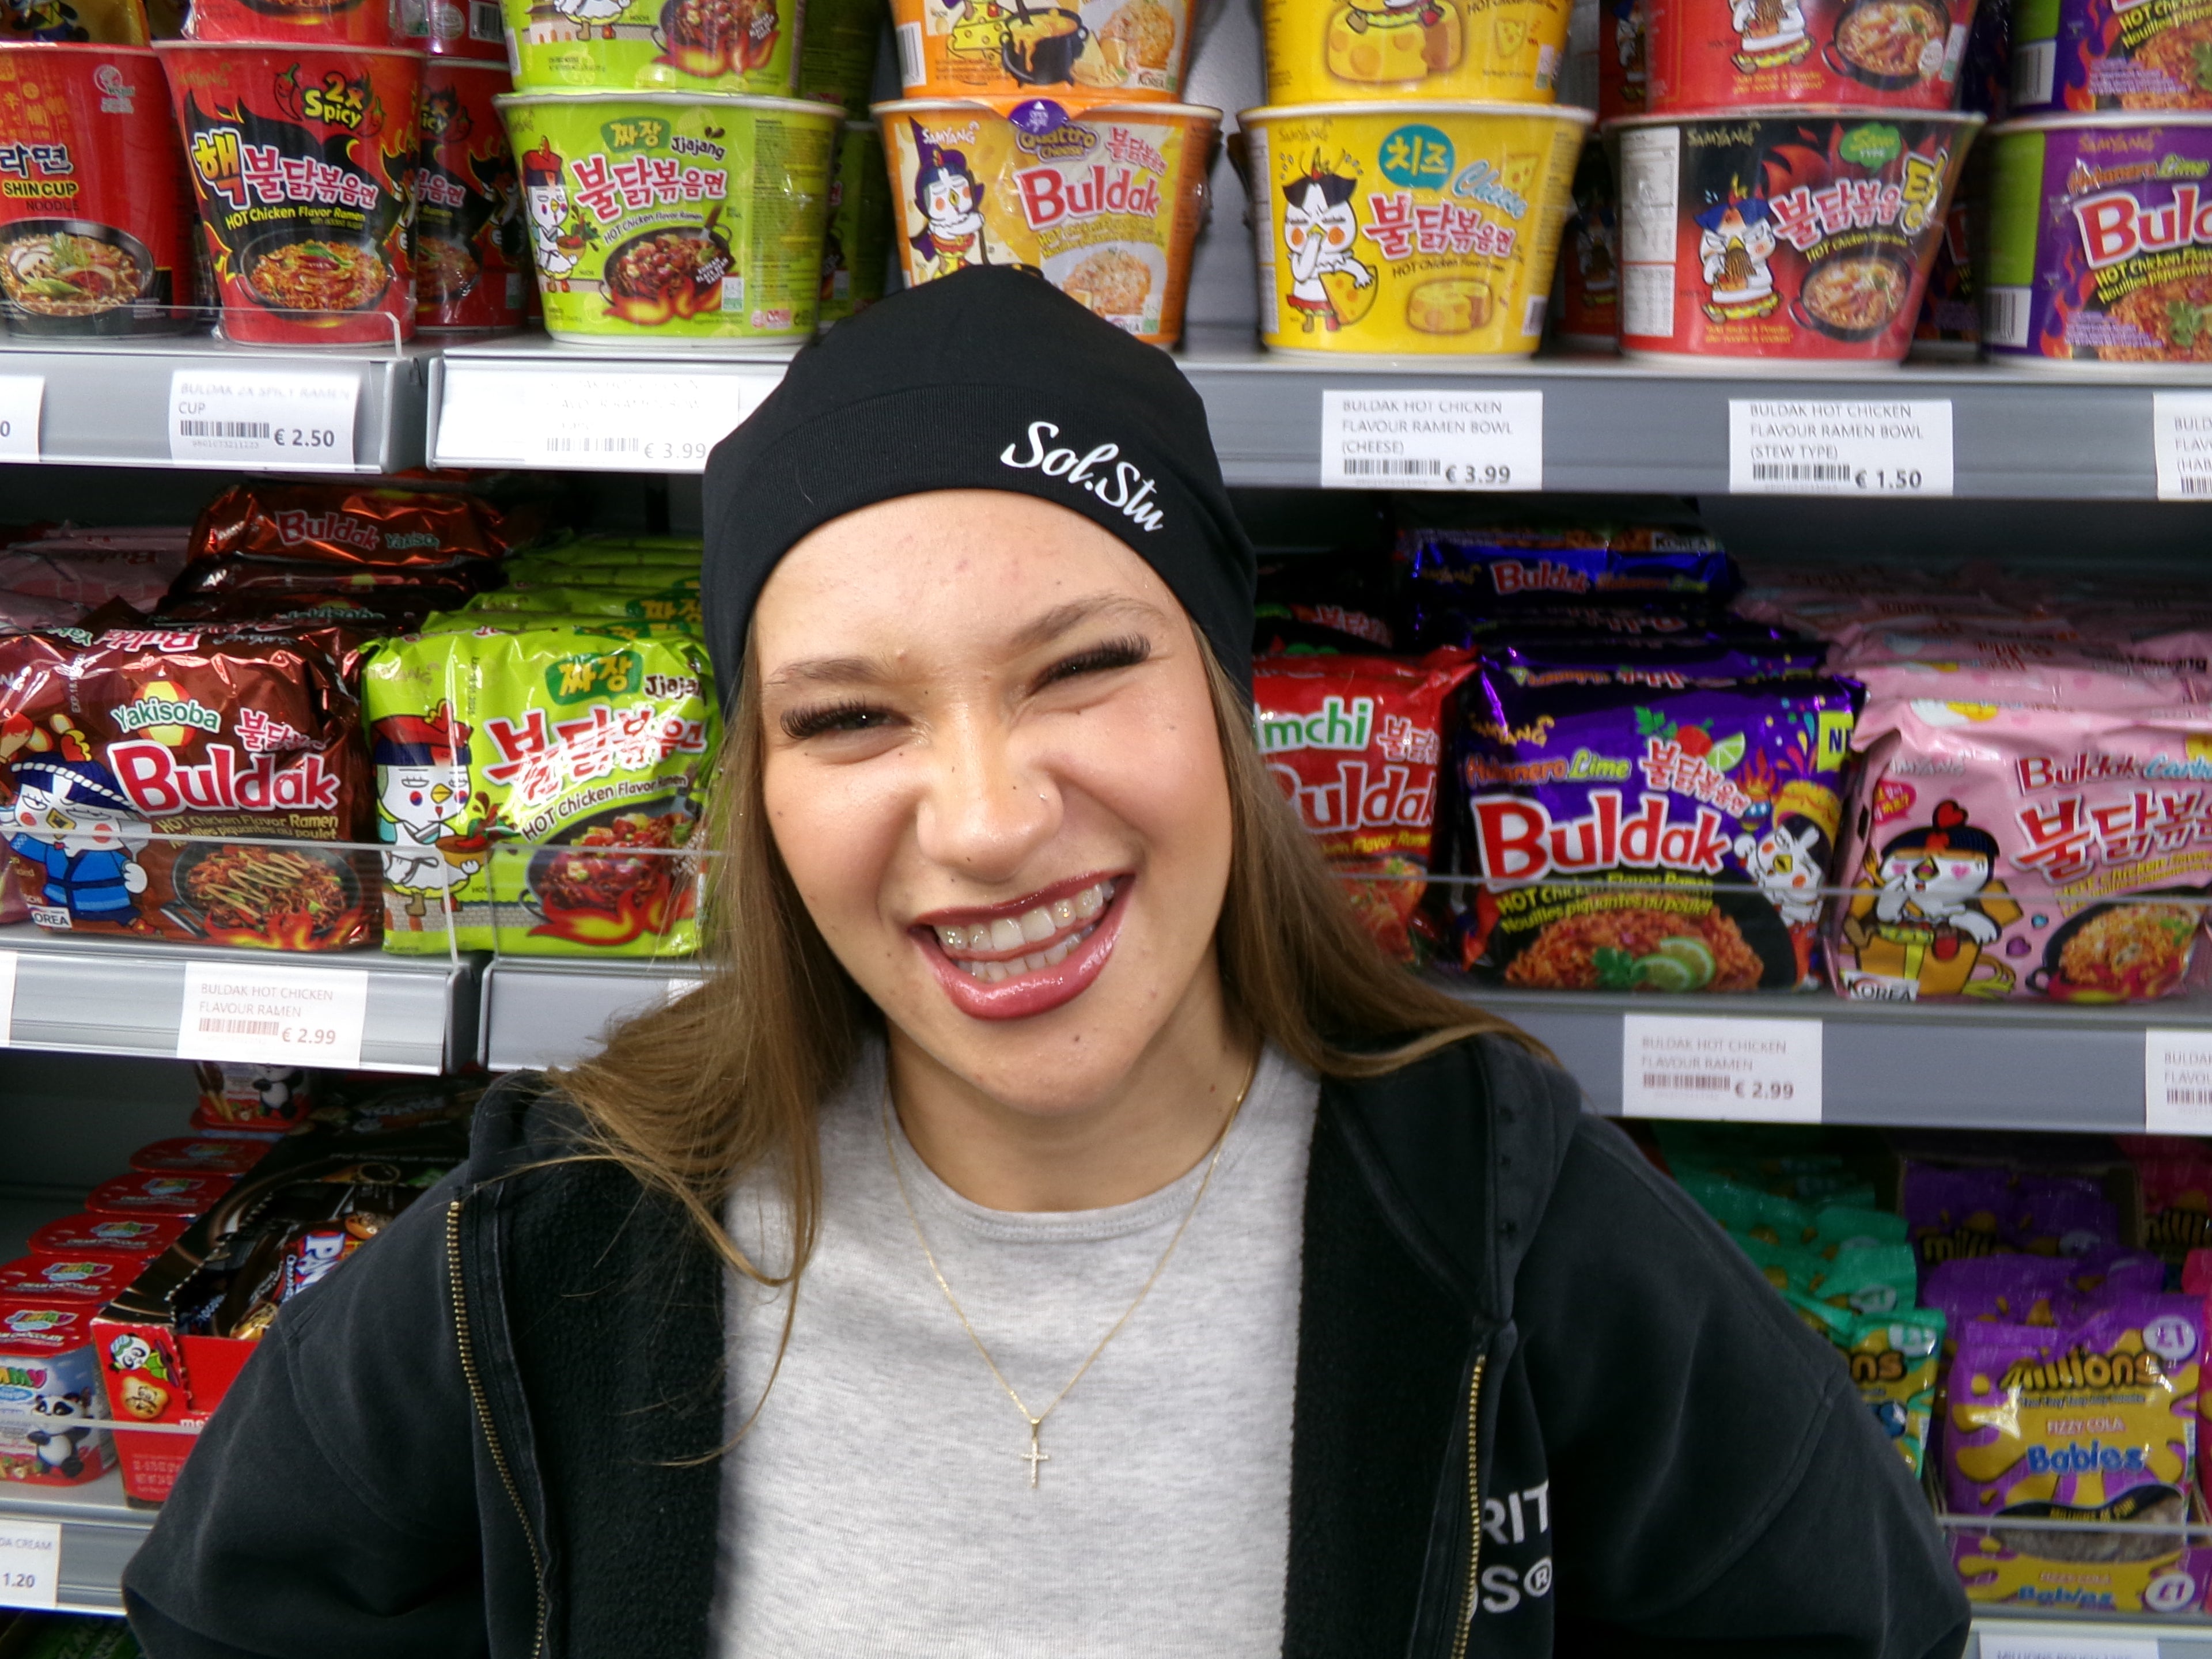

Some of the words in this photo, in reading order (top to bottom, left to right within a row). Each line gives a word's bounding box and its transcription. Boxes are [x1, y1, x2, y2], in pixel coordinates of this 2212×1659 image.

[2118, 3, 2152, 32] HOT
[324, 71, 365, 112] 2x
[303, 89, 363, 130] Spicy
[611, 120, 662, 149] 짜장
[922, 127, 977, 146] SAMYANG
[671, 135, 726, 161] Jjajang
[1385, 135, 1448, 177] 치즈
[0, 142, 74, 179] 라면
[3, 181, 40, 196] SHIN
[41, 181, 78, 197] CUP
[570, 153, 728, 224] 불닭볶음면
[1012, 164, 1162, 232] Buldak
[26, 200, 79, 211] NOODLE
[225, 210, 249, 230] HOT
[249, 206, 296, 222] Chicken
[298, 206, 332, 218] Flavor
[334, 207, 366, 222] Ramen
[1362, 191, 1517, 260] 불닭볶음면
[604, 228, 622, 245] HOT
[622, 213, 654, 230] Chicken
[1806, 245, 1830, 263] HOT
[1392, 266, 1418, 279] HOT
[1419, 258, 1459, 272] Chicken
[2094, 260, 2128, 287] HOT
[179, 401, 206, 414] CUP
[1343, 400, 1400, 413] BULDAK
[1404, 400, 1433, 413] HOT
[1440, 400, 1503, 414] CHICKEN
[1750, 403, 1808, 417] BULDAK
[1812, 403, 1842, 418] HOT
[1847, 403, 1912, 419] CHICKEN
[1342, 419, 1408, 434] FLAVOUR
[1412, 420, 1466, 434] RAMEN
[1471, 421, 1514, 435] BOWL
[1750, 423, 1817, 438] FLAVOUR
[1821, 423, 1876, 439] RAMEN
[1880, 425, 1924, 440] BOWL
[274, 428, 286, 446] €
[292, 429, 335, 448] 2.50
[1342, 440, 1404, 456] (CHEESE)
[644, 443, 654, 459] €
[663, 443, 707, 459] 3.99
[1750, 444, 1795, 460] (STEW
[1799, 444, 1839, 460] TYPE)
[1445, 464, 1457, 483] €
[1465, 464, 1512, 484] 3.99
[1855, 468, 1868, 489] €
[1877, 468, 1922, 489] 1.50
[275, 509, 380, 551] Buldak
[1489, 558, 1592, 596] Buldak
[559, 656, 632, 696] 짜장
[110, 698, 221, 734] Yakisoba
[1255, 695, 1374, 752] mchi
[1567, 747, 1631, 782] Lime
[107, 740, 341, 816] Buldak
[522, 808, 556, 842] HOT
[558, 786, 615, 818] Chicken
[616, 780, 656, 797] Flavor
[156, 815, 190, 834] HOT
[189, 814, 241, 827] Chicken
[241, 814, 287, 828] Flavor
[289, 813, 339, 828] Ramen
[295, 827, 338, 840] poulet
[1472, 790, 1733, 893] Buldak
[1495, 885, 1538, 915] HOT
[34, 912, 70, 926] OREA
[200, 983, 249, 997] BULDAK
[252, 986, 278, 998] HOT
[281, 987, 334, 1001] CHICKEN
[1847, 979, 1911, 1002] KOREA
[199, 1001, 255, 1015] FLAVOUR
[257, 1004, 302, 1018] RAMEN
[282, 1027, 291, 1043] €
[297, 1028, 336, 1046] 2.99
[1642, 1036, 1694, 1051] BULDAK
[1697, 1037, 1724, 1052] HOT
[1729, 1039, 1787, 1055] CHICKEN
[1642, 1056, 1700, 1070] FLAVOUR
[1705, 1058, 1754, 1072] RAMEN
[1734, 1080, 1746, 1099] €
[1751, 1081, 1795, 1100] 2.99
[2047, 1419, 2084, 1435] FIZZY
[2086, 1416, 2126, 1433] COLA
[16, 1538, 52, 1550] CREAM
[3, 1573, 36, 1588] 1.20
